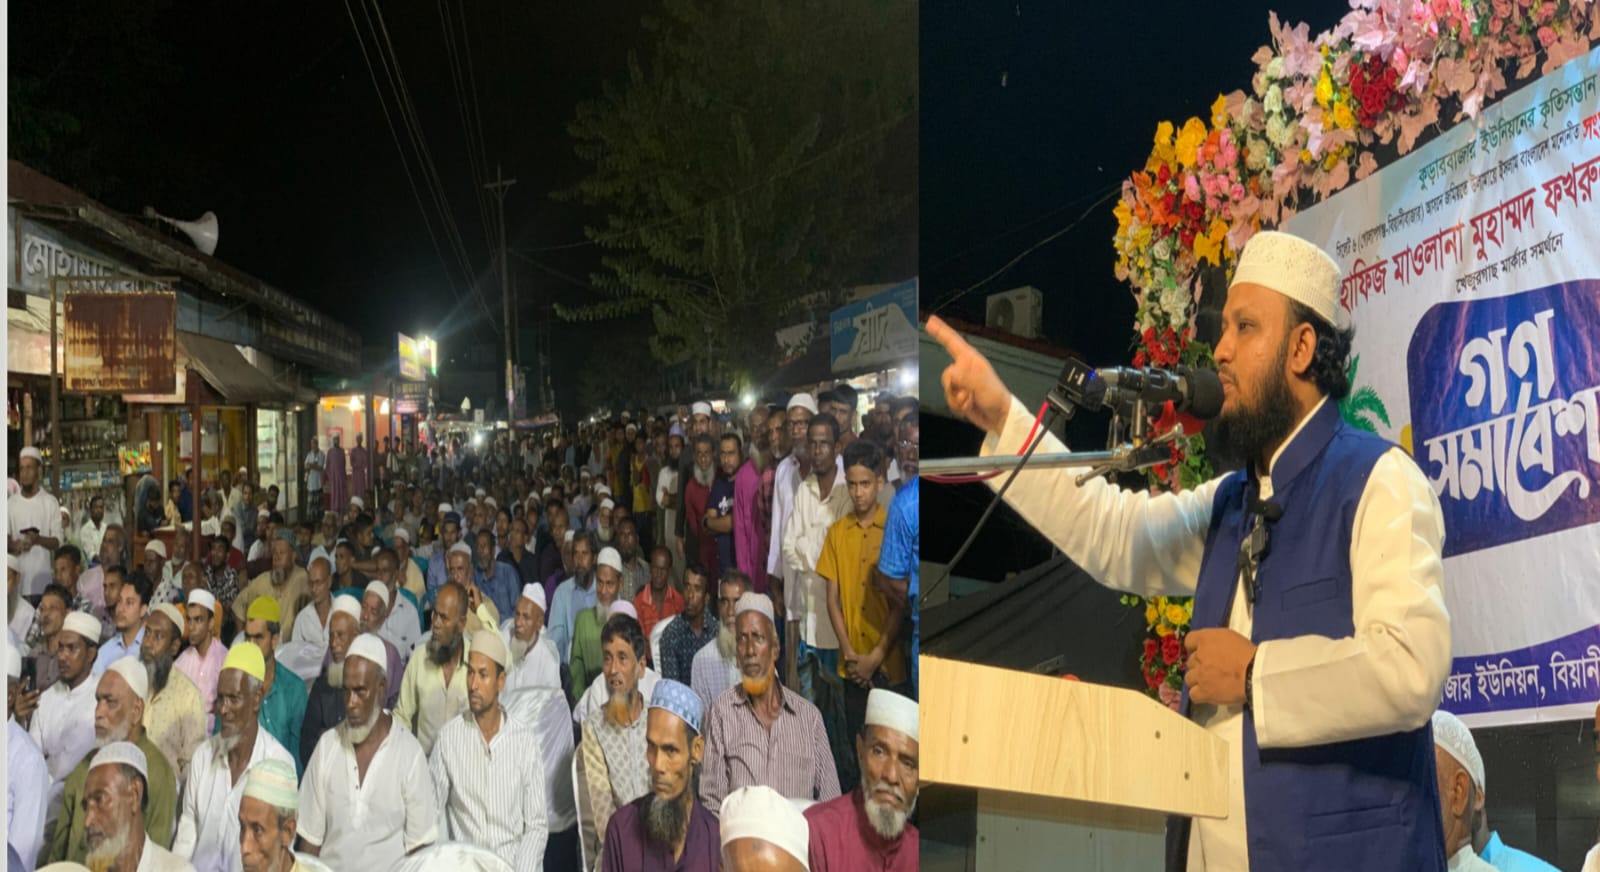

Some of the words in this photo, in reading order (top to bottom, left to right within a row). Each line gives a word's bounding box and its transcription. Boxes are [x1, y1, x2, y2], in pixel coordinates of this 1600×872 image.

[1418, 139, 1477, 191] কুড়ারবাজার
[1480, 107, 1537, 154] ইউনিয়নের
[1539, 74, 1598, 129] কৃতিসন্তান
[1339, 258, 1388, 315] হাফিজ
[1392, 220, 1465, 287] মাওলানা
[1469, 187, 1537, 262] মুহাম্মদ
[1541, 155, 1600, 217] ফখরু
[1456, 263, 1499, 293] খেজুরগাছ
[1500, 246, 1528, 273] মার্কার
[1530, 230, 1564, 261] সমর্থনে
[1459, 309, 1555, 415] গণ
[1423, 384, 1600, 522] সমাবেশ
[1475, 658, 1546, 701] ইউনিয়ন,
